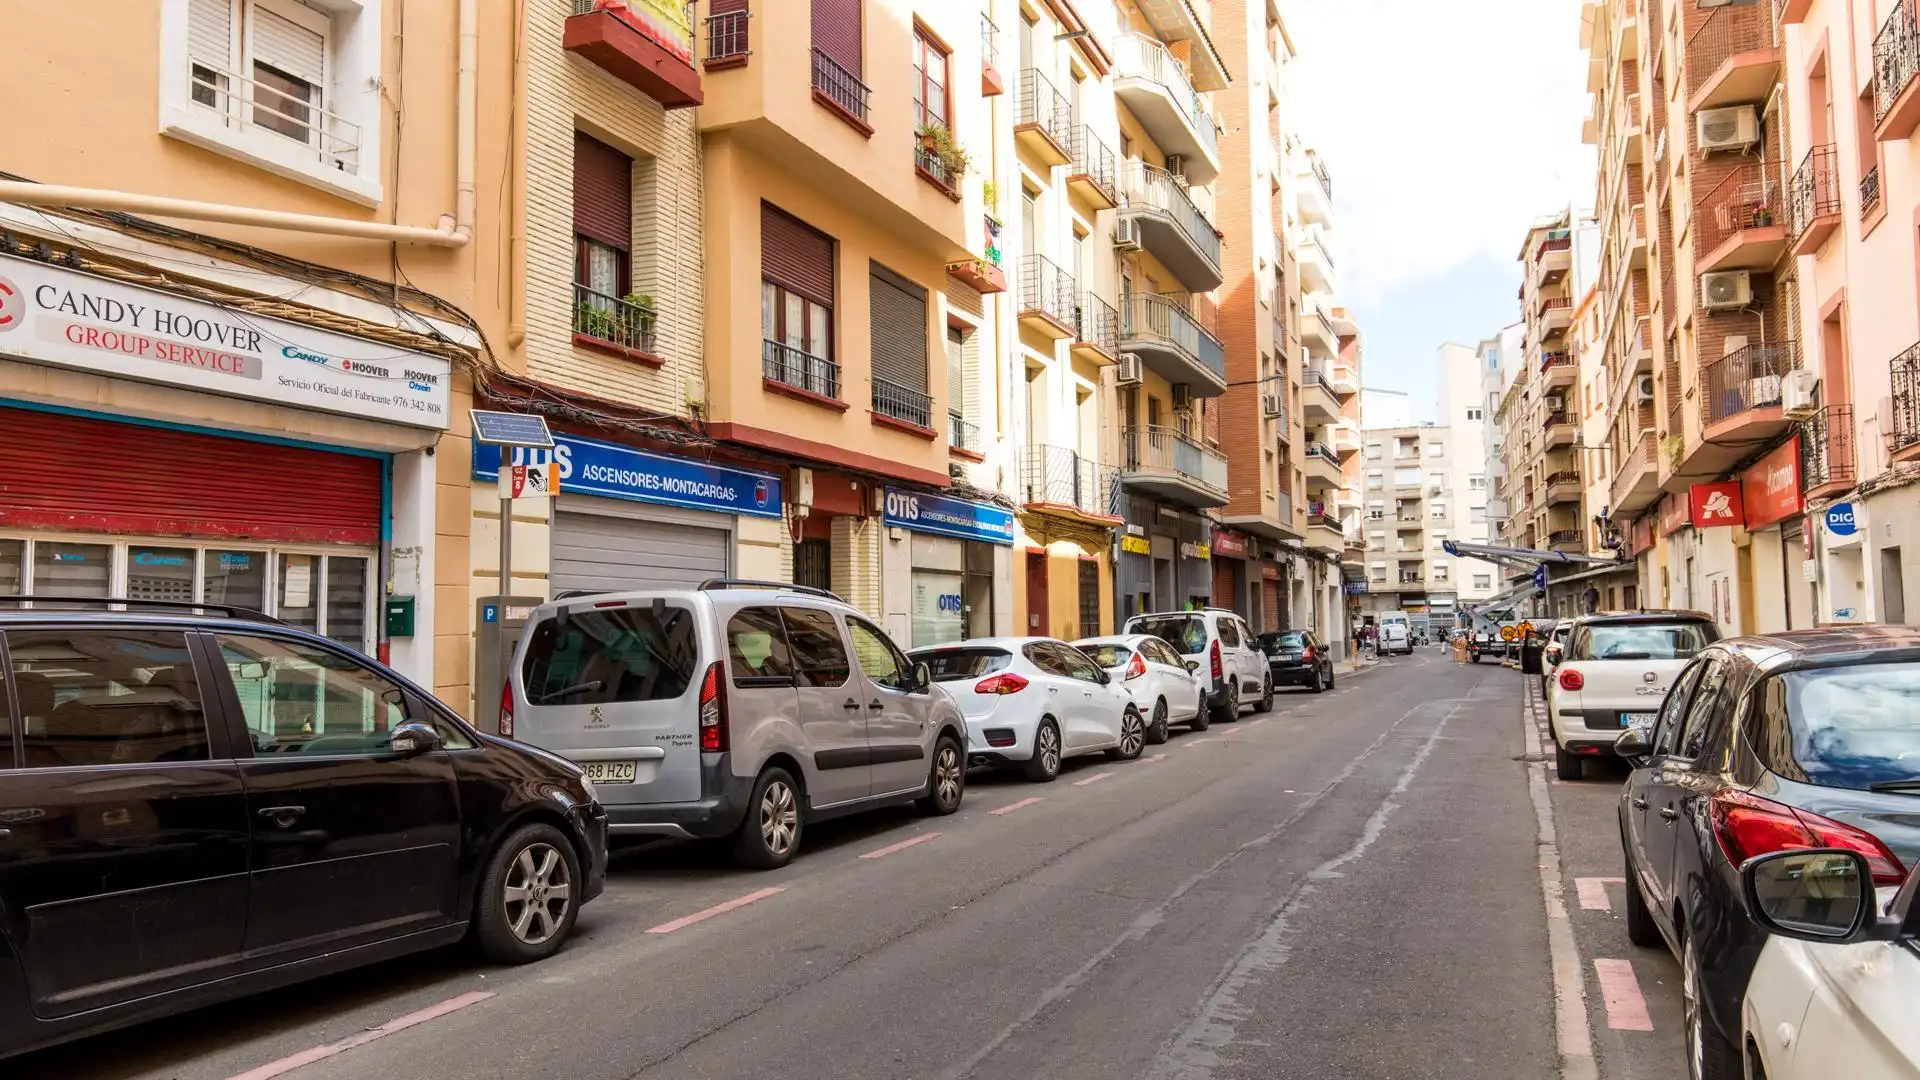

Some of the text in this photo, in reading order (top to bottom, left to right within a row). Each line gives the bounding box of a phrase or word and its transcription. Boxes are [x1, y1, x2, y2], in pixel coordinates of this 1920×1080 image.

[35, 284, 262, 353] CANDY HOOVER
[66, 324, 244, 374] GROUP SERVICE
[281, 345, 329, 365] CANDY
[352, 361, 389, 378] HOOVER
[404, 369, 438, 384] HOOVER
[278, 375, 441, 415] Servicio Oficial del Fabricante 976 342 808
[887, 492, 919, 520] OTIS
[938, 594, 961, 611] OTIS
[655, 733, 693, 741] PARTNER
[607, 763, 632, 778] HZC
